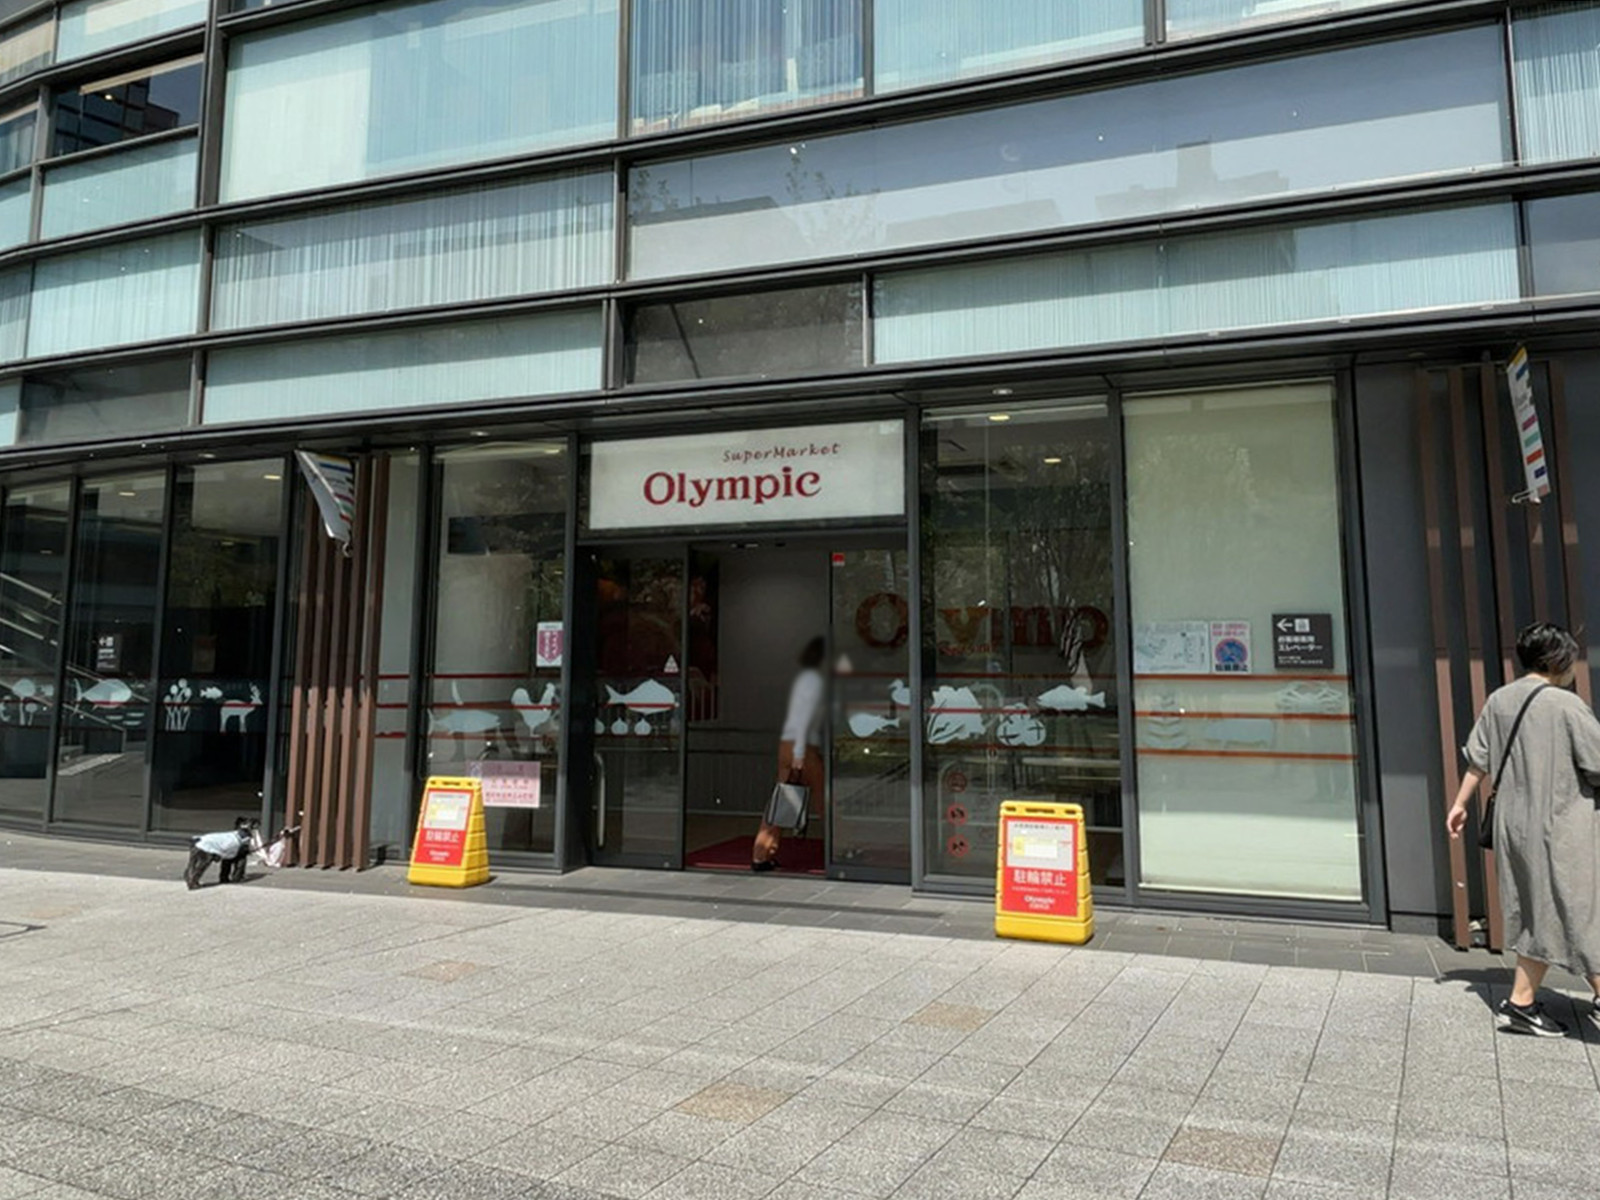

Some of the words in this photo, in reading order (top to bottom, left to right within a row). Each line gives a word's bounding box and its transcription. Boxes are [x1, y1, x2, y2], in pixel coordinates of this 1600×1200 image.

[723, 443, 841, 464] SuperMarket
[643, 466, 822, 508] Olympic
[1013, 869, 1067, 887] 駐輪禁止
